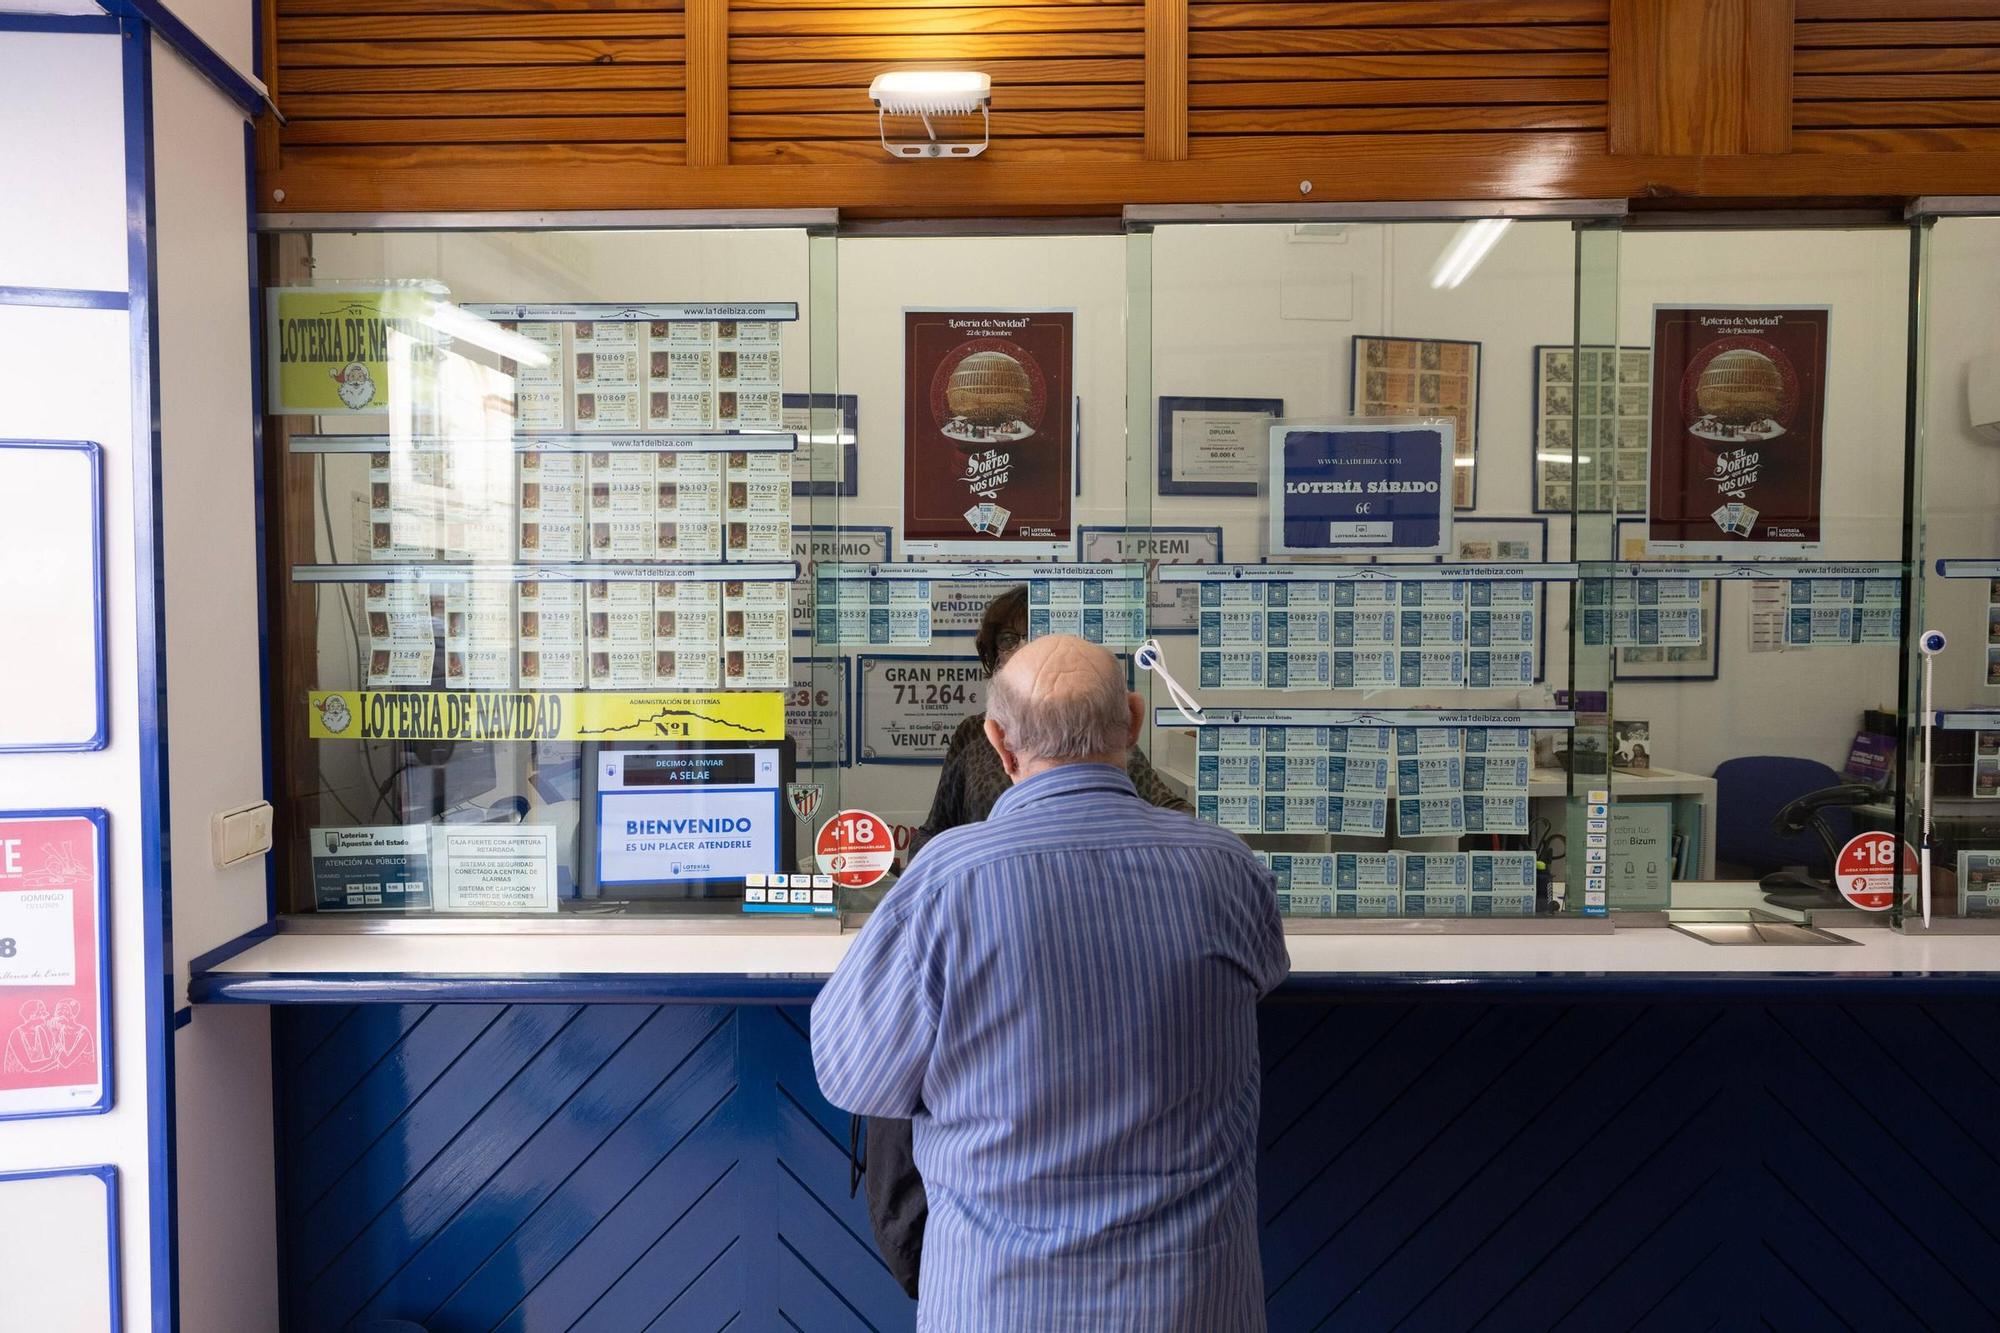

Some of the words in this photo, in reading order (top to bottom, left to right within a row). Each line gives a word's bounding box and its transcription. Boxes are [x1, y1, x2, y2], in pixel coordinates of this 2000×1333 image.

[948, 318, 980, 329] Lotería
[981, 319, 992, 327] de
[992, 317, 1030, 328] Navidad
[1700, 316, 1731, 327] Lotería
[1732, 317, 1743, 325] de
[1744, 315, 1783, 326] Navidad
[982, 329, 1013, 337] Diciembre
[280, 318, 344, 362] LOTERIA
[345, 318, 367, 362] DE
[671, 353, 699, 361] 83440
[739, 353, 768, 361] 44748
[984, 449, 997, 460] EL
[1733, 448, 1746, 459] EL
[965, 453, 1010, 477] SORTEO
[1713, 451, 1759, 475] SORTEO
[679, 484, 708, 492] 95103
[749, 484, 778, 492] 27692
[969, 479, 988, 494] NOS
[988, 471, 1009, 488] UNE
[1286, 480, 1363, 493] LOTERÍA
[1367, 479, 1438, 493] SÁBADO
[1717, 478, 1736, 494] NOS
[1736, 472, 1758, 488] UNE
[1355, 502, 1372, 514] 6€
[813, 543, 871, 555] PREMIO
[1137, 540, 1190, 553] PREMI
[1422, 653, 1450, 661] 47806
[885, 668, 931, 682] GRAN
[937, 668, 983, 682] PREMI
[815, 690, 829, 707] €
[893, 684, 966, 705] 71.264
[969, 693, 977, 704] €
[629, 697, 682, 706] ADMINISTRACIÓN
[692, 697, 721, 706] LOTERÍAS
[360, 693, 443, 738] LOTERIA
[446, 693, 473, 738] DE
[476, 693, 562, 739] NAVIDAD
[654, 722, 690, 736] Nº1
[891, 734, 936, 746] VENUT
[695, 759, 724, 767] ENVIAR
[669, 771, 678, 780] A
[679, 771, 710, 780] SELAE
[1219, 797, 1247, 805] 96513
[1344, 799, 1373, 807] 35791
[626, 817, 752, 836] BIENVENIDO
[831, 818, 874, 843] +18
[341, 840, 373, 848] Apuestas
[626, 843, 637, 852] ES
[640, 842, 655, 851] UN
[659, 841, 695, 850] PLACER
[699, 840, 752, 849] ATENDERLE
[1629, 837, 1656, 845] Bizum
[1852, 840, 1895, 865] +18
[325, 857, 362, 867] ATENCIÓN
[375, 856, 407, 865] PÚBLICO
[20, 893, 64, 902] DOMINGO
